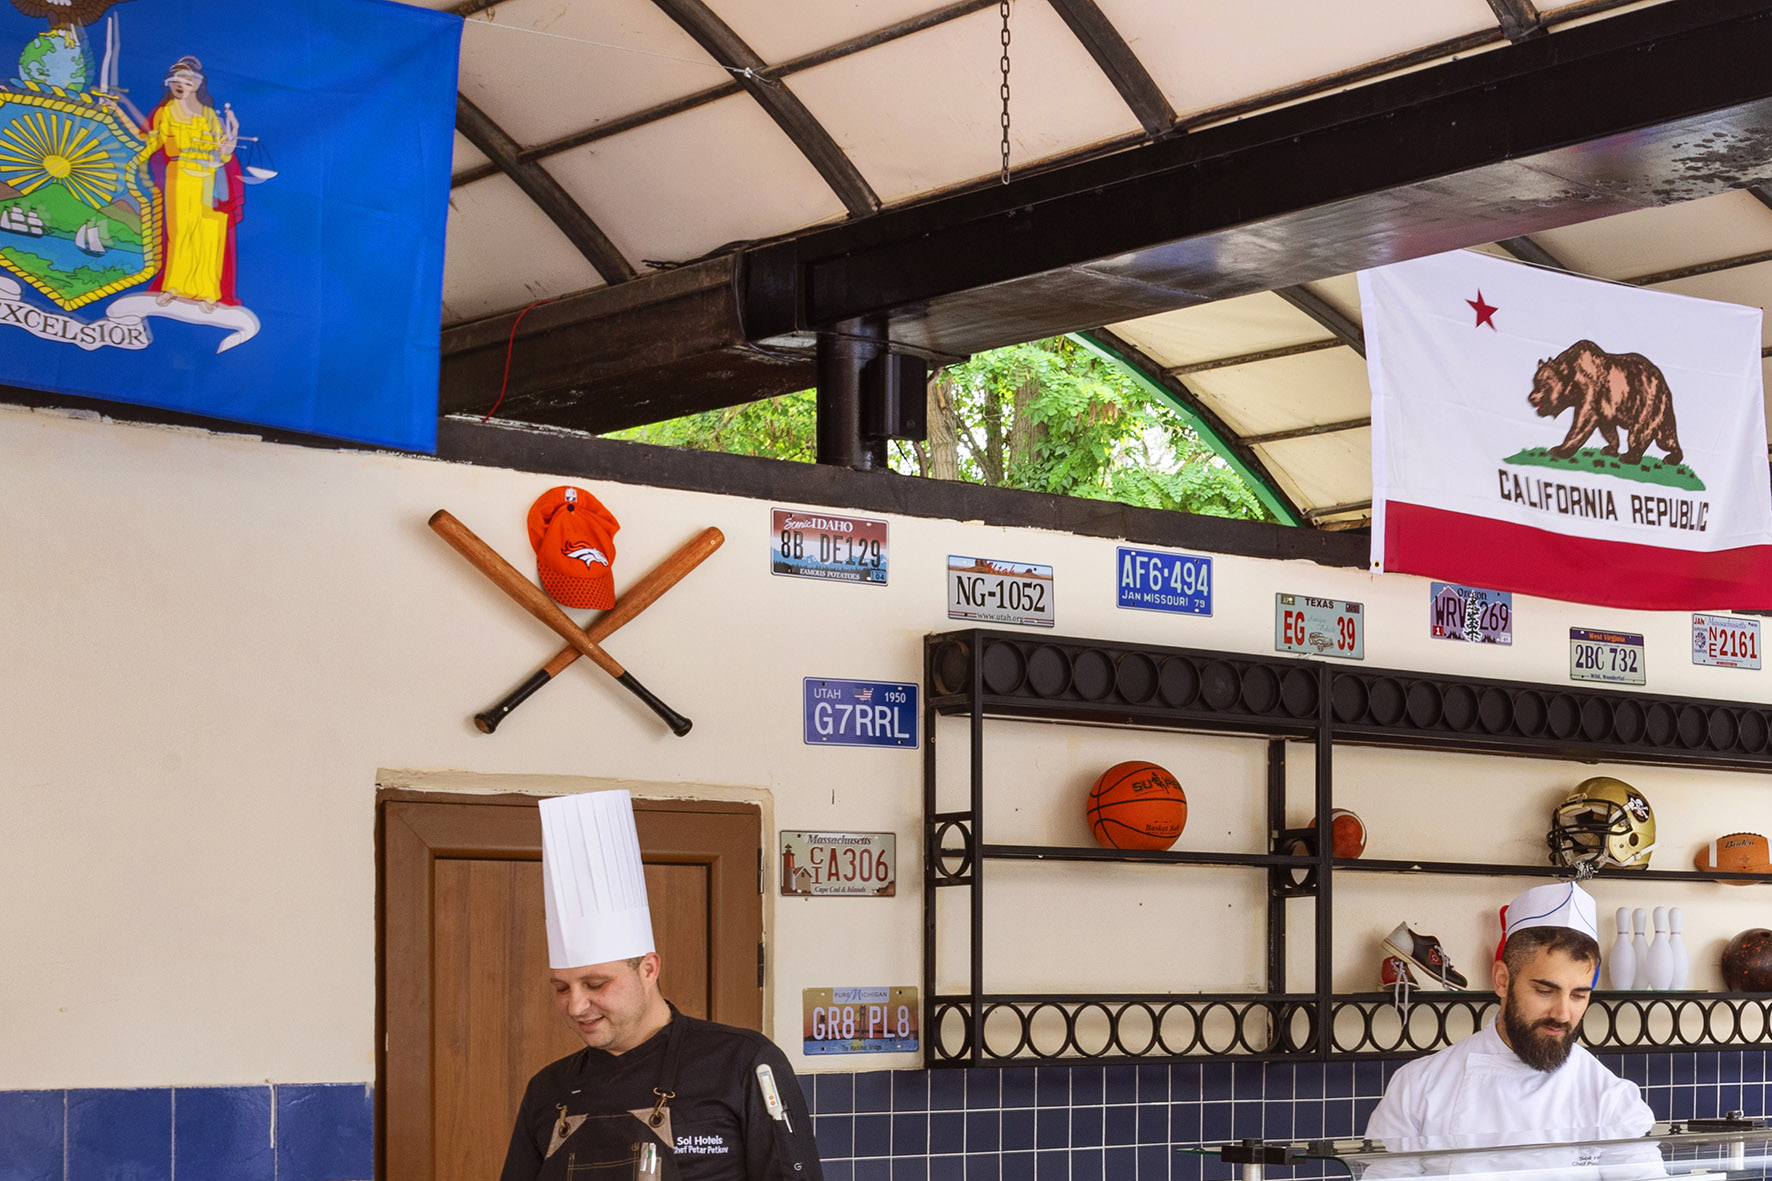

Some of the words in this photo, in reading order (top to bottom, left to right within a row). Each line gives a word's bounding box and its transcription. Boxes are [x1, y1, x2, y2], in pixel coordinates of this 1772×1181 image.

[0, 302, 145, 346] XCELSIOR
[1498, 468, 1618, 521] CALIFORNIA
[1630, 494, 1709, 532] REPUBLIC
[811, 518, 853, 533] IDAHO
[781, 530, 804, 560] 8B
[820, 533, 881, 568] DE129
[800, 568, 826, 577] FAMOUS
[827, 570, 860, 580] POTATOES
[986, 562, 1016, 577] Utah
[956, 575, 1045, 612] NG-1052
[1121, 589, 1141, 600] JAN
[1143, 592, 1188, 606] MISSOURI
[1194, 599, 1205, 608] 79
[1305, 597, 1334, 609] TEXAS
[977, 612, 1025, 624] www.utah.org
[1434, 595, 1468, 628] WRV
[1479, 601, 1509, 632] 269
[1693, 617, 1705, 625] JAN
[1283, 609, 1305, 646] EG
[1336, 616, 1356, 652] 39
[1435, 627, 1441, 635] 1
[1588, 632, 1603, 640] West
[1603, 634, 1626, 643] Virginia
[1719, 629, 1757, 659] 2161
[1575, 644, 1605, 670] 2BC
[1609, 647, 1638, 673] 732
[813, 687, 841, 699] UTAH
[884, 691, 906, 703] 1950
[814, 701, 910, 738] G7RRL
[807, 834, 872, 845] Massachusetts
[827, 847, 888, 882] A306
[813, 1006, 855, 1040] GR8
[869, 1005, 910, 1038] PL8
[676, 1135, 692, 1146] Sol
[694, 1135, 723, 1146] Hotels
